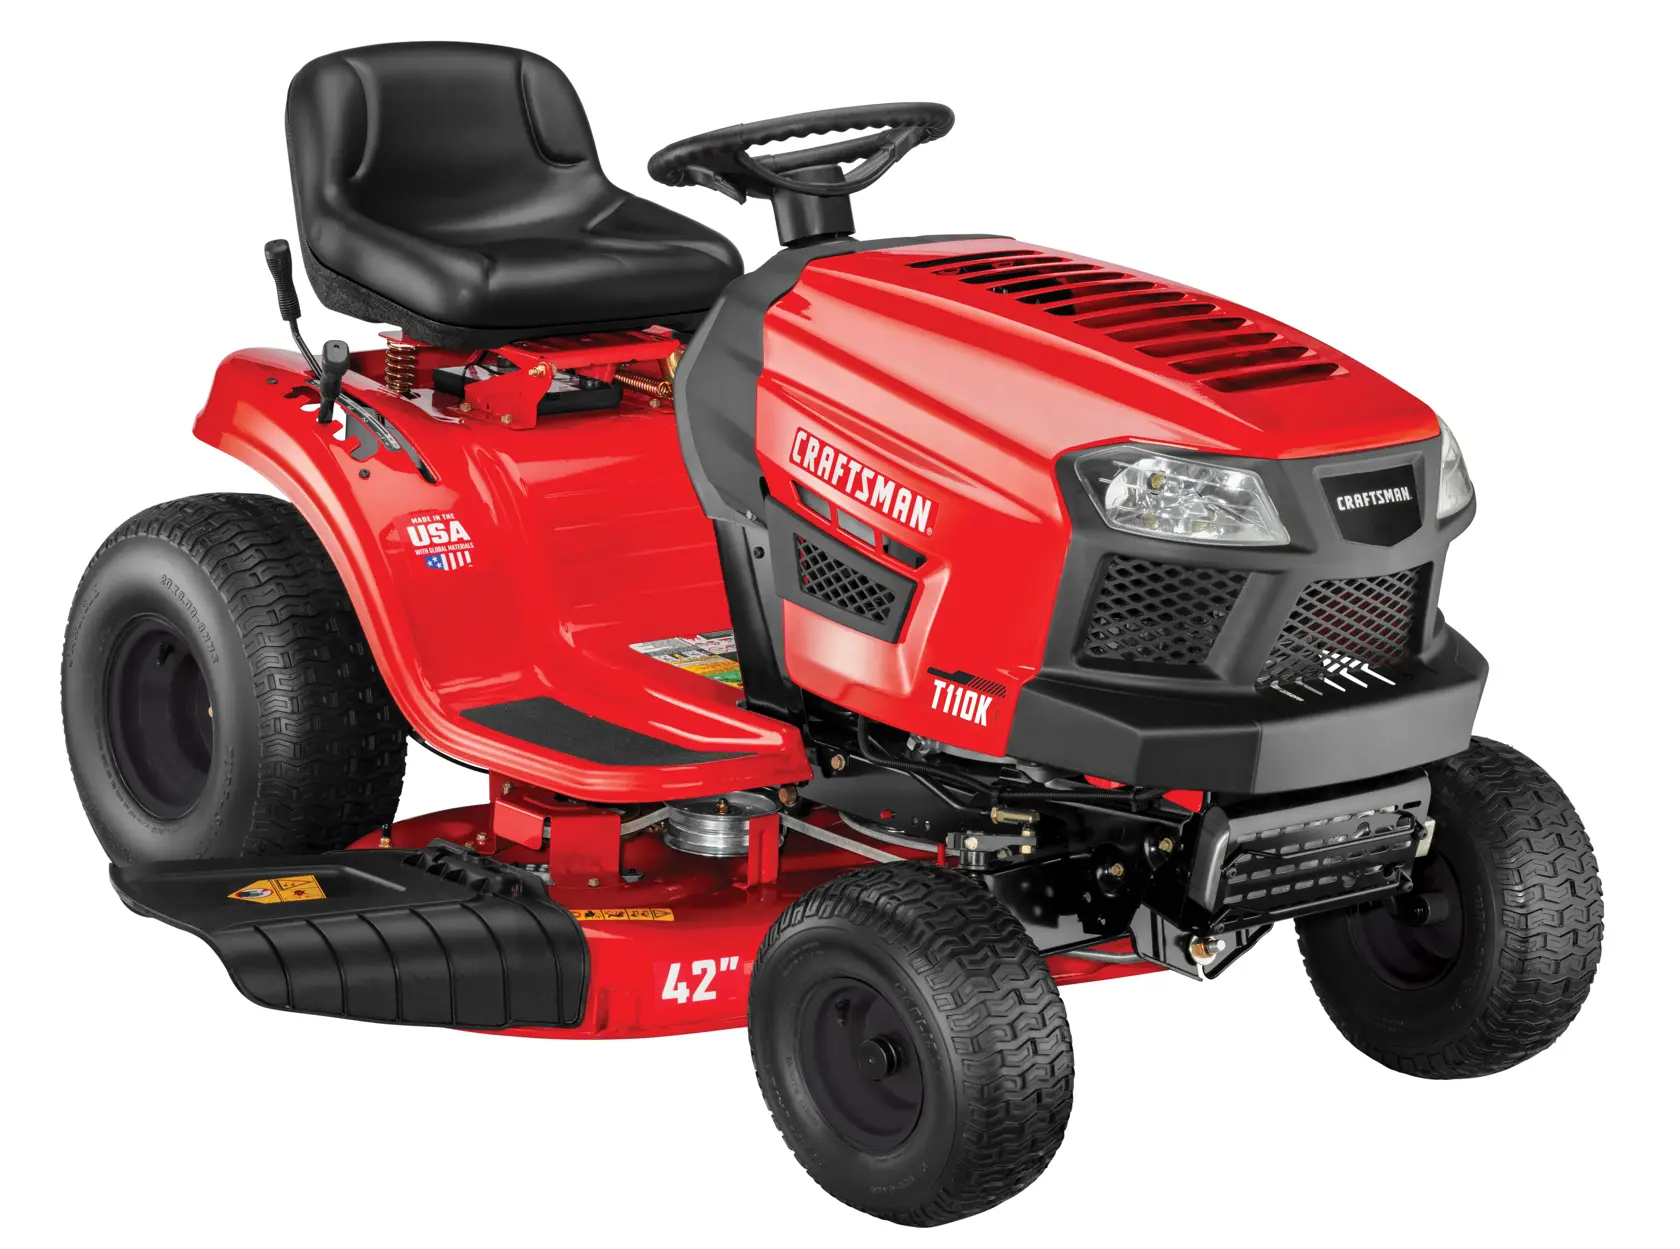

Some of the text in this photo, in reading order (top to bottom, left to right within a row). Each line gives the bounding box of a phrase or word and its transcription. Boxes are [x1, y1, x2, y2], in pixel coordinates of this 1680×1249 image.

[792, 430, 932, 533] CRAFTSMAN
[1336, 486, 1409, 511] CRAFTSMAN
[411, 515, 431, 524] MADE
[406, 520, 471, 547] USA
[429, 545, 447, 553] GLOBAL
[448, 542, 474, 550] MATERIALS
[931, 679, 993, 727] T110K
[661, 956, 740, 1004] 42"
